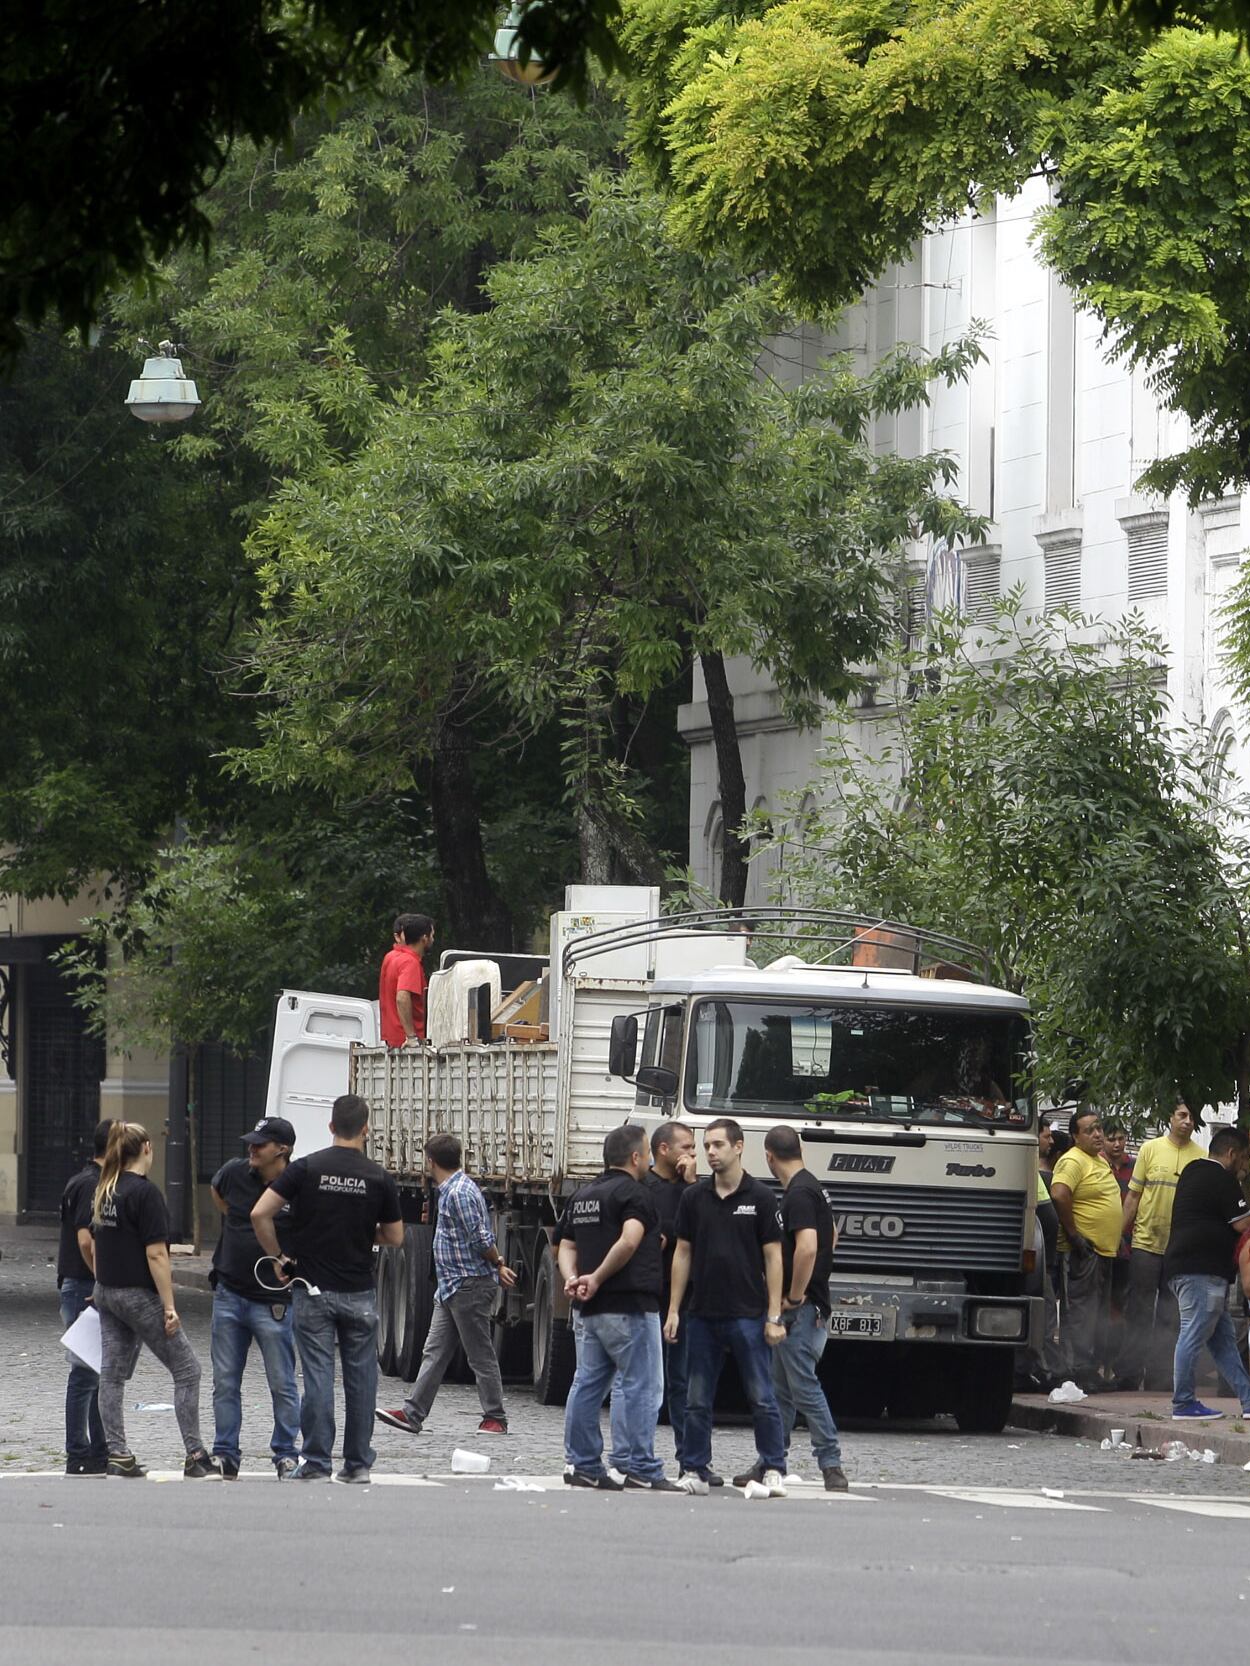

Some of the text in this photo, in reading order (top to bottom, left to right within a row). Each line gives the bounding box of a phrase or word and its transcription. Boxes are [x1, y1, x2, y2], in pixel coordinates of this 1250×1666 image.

[832, 1156, 892, 1170] FIAT
[945, 1162, 996, 1178] Turbo
[320, 1174, 367, 1189] POLICIA
[572, 1200, 600, 1214] POLICIA
[833, 1214, 904, 1238] VECO
[860, 1318, 880, 1332] 813
